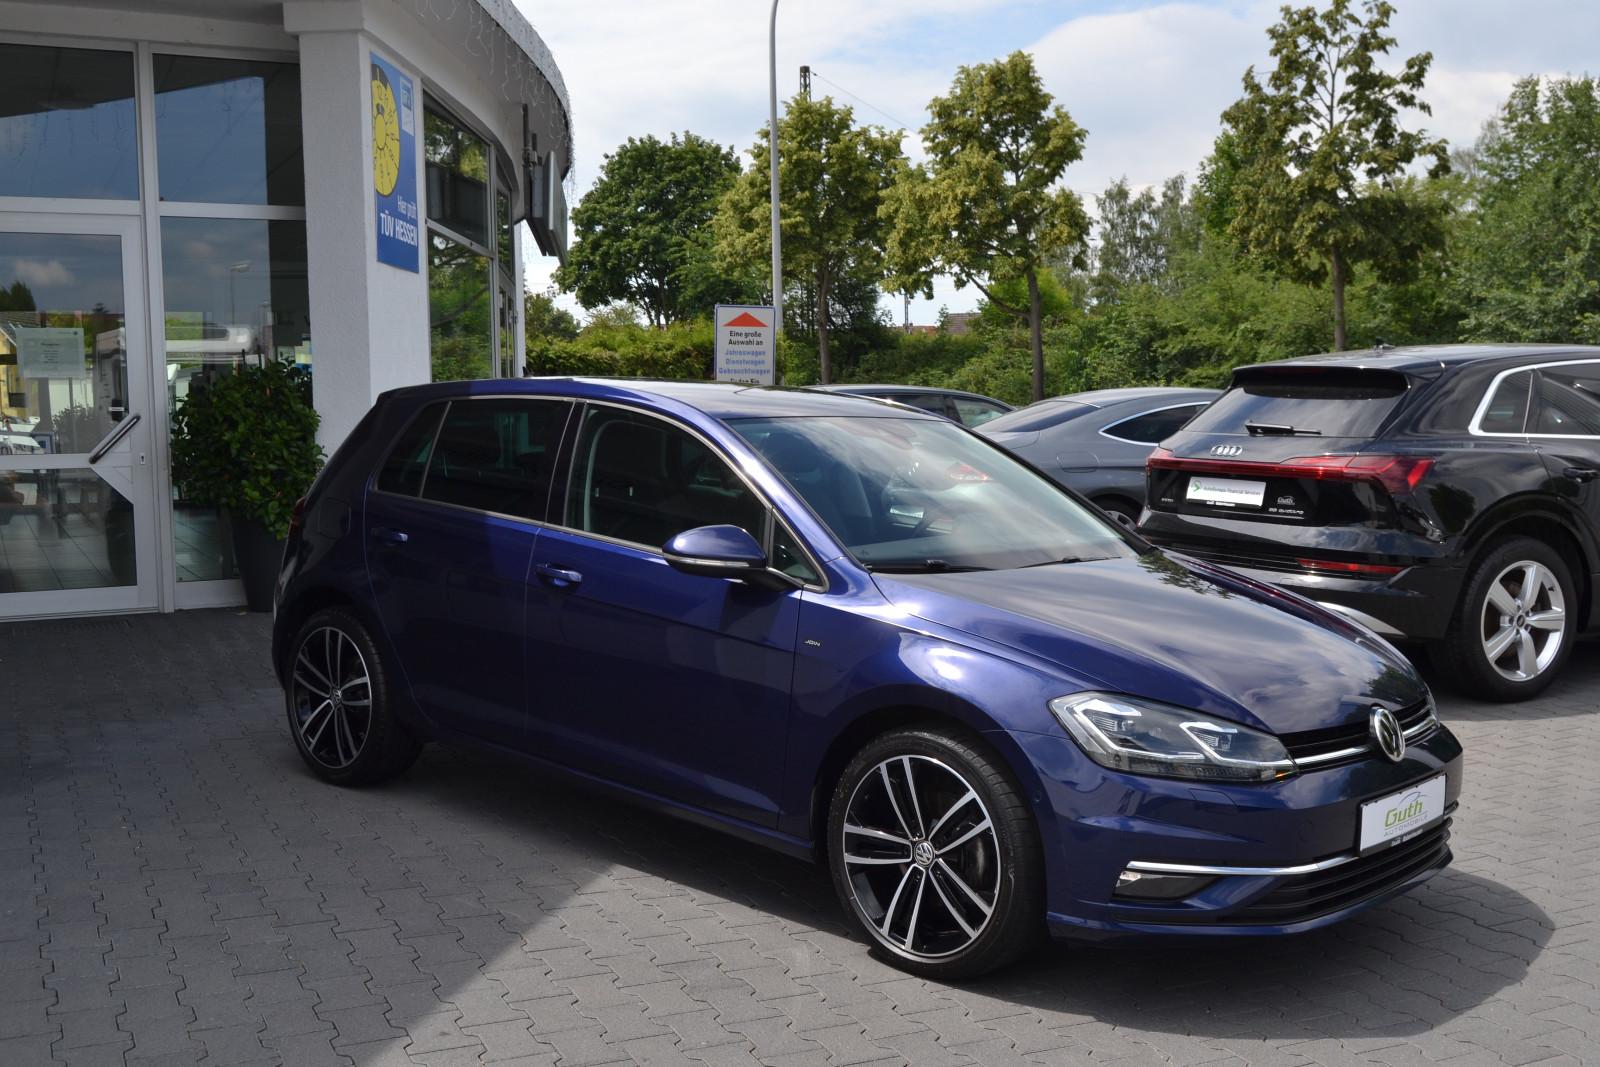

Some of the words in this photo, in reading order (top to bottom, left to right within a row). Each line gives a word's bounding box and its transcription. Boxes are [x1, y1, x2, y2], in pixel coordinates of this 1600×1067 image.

[380, 210, 394, 238] TÜV
[395, 218, 418, 247] HESSEN
[744, 330, 762, 338] große
[1383, 813, 1429, 837] AUTOMOBILE
[1384, 800, 1423, 828] Guth
